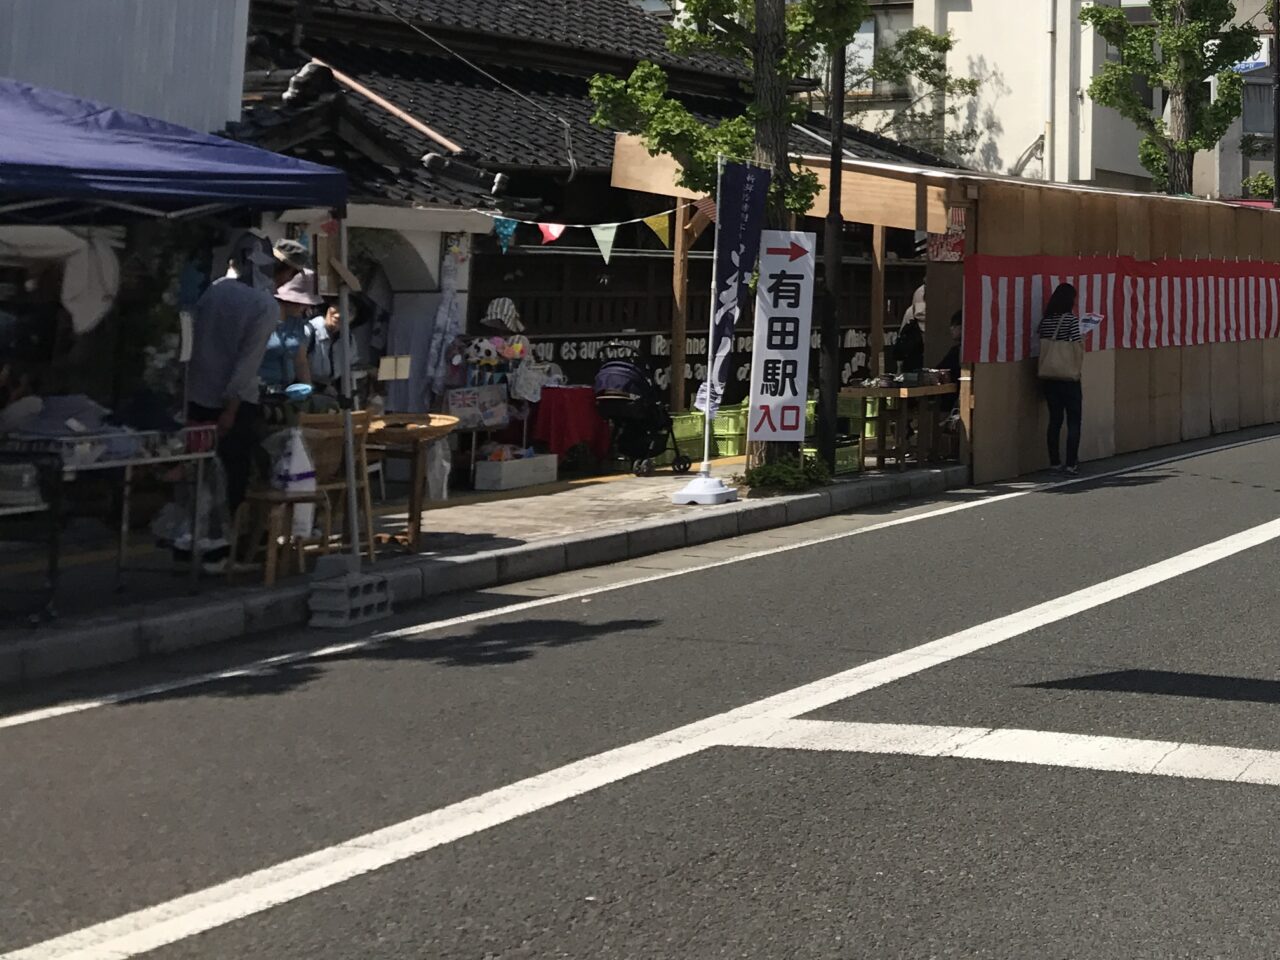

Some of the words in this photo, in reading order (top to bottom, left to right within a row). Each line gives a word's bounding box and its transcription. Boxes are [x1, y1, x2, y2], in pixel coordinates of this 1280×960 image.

[759, 270, 804, 398] 有田駅
[754, 404, 800, 433] 入口
